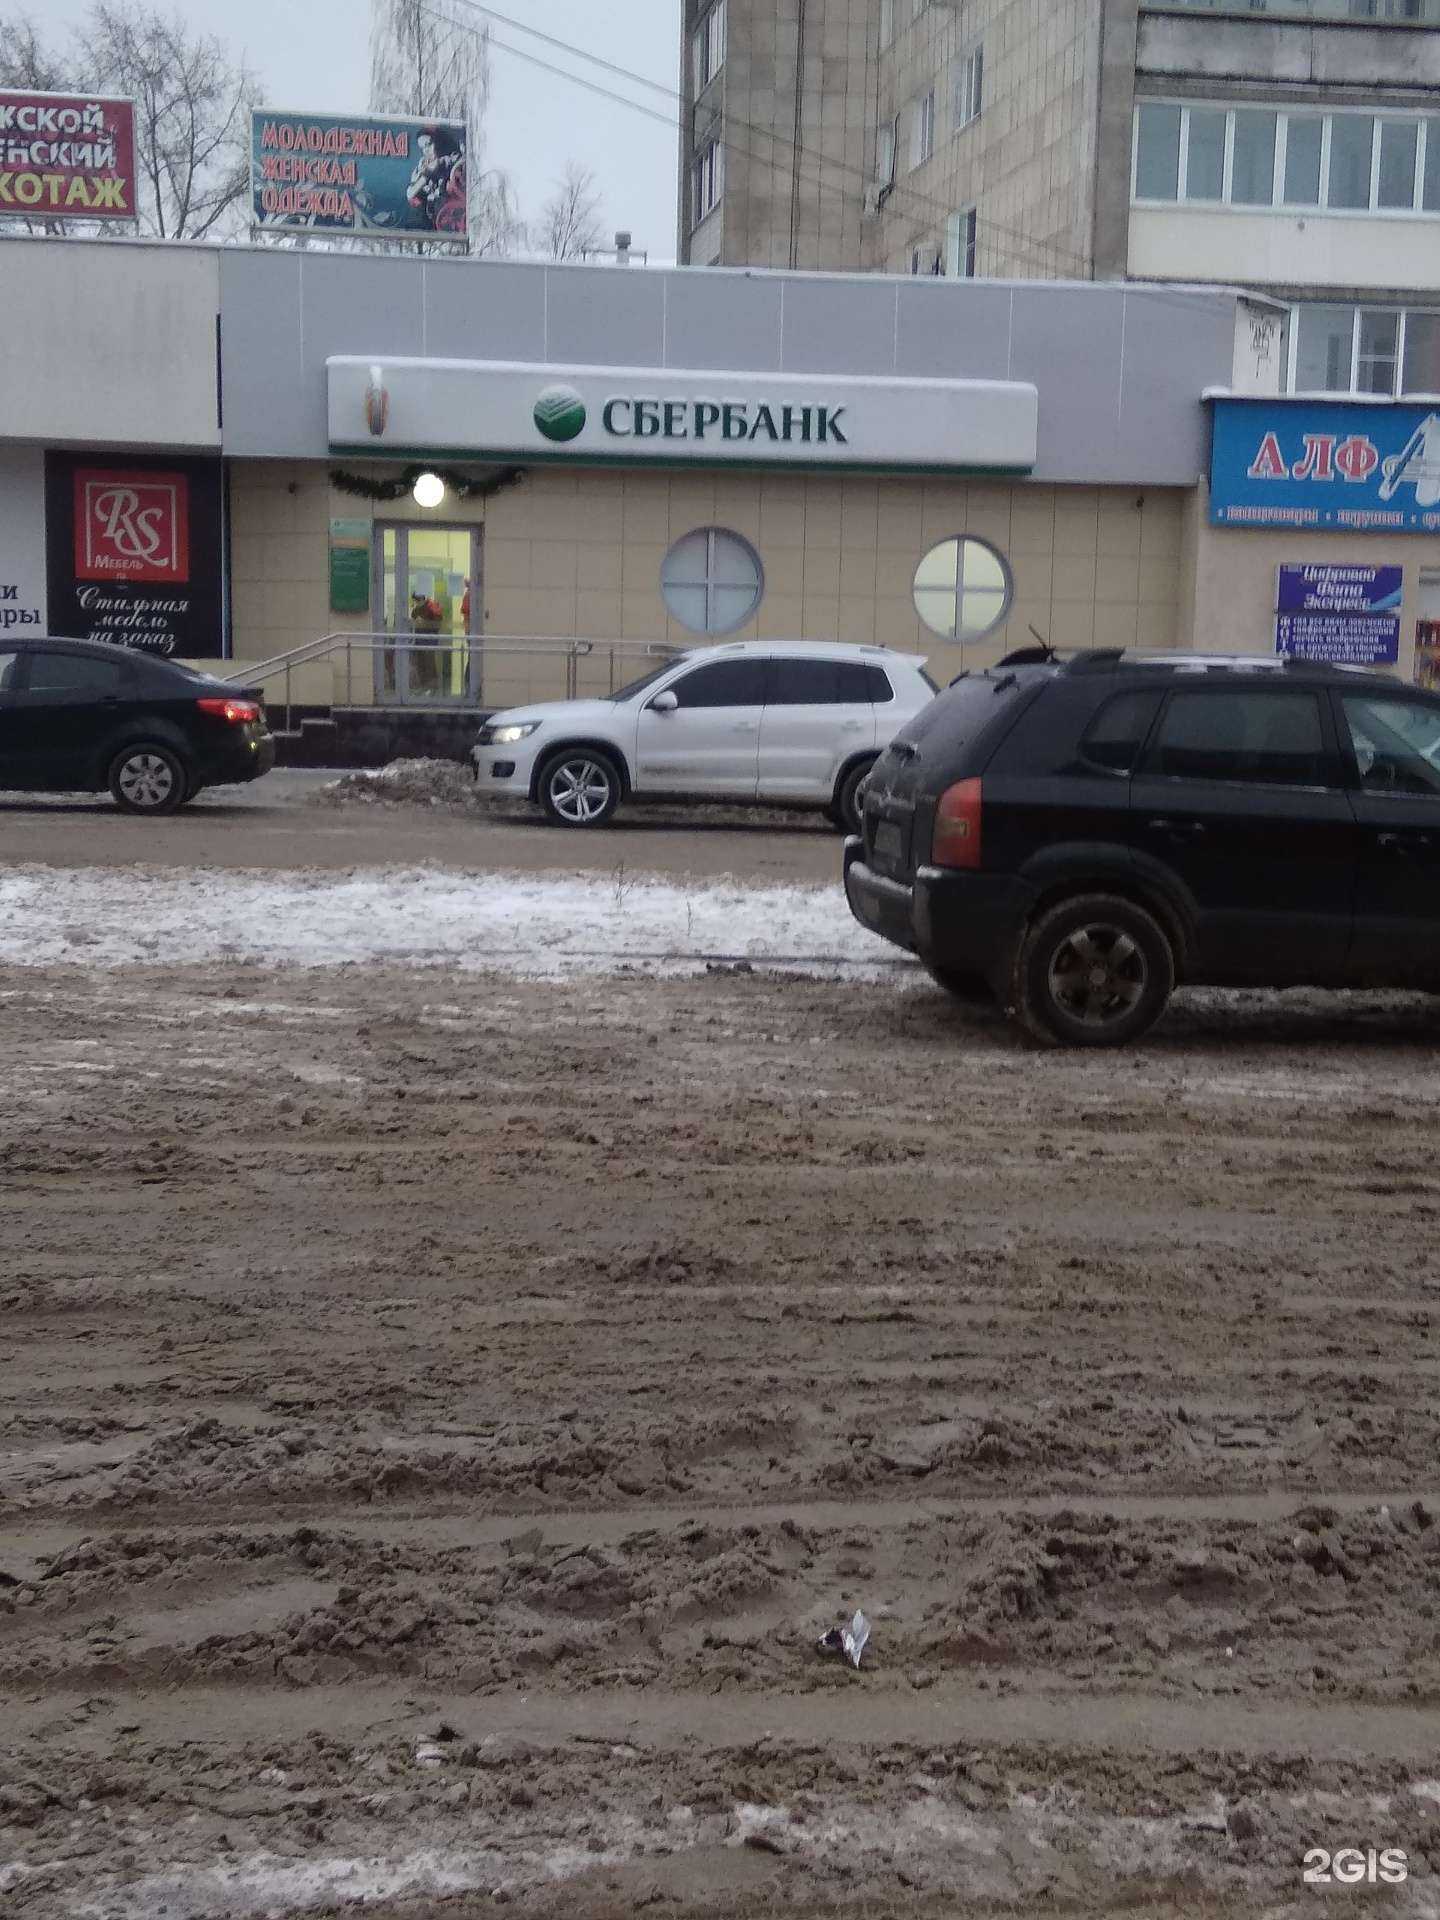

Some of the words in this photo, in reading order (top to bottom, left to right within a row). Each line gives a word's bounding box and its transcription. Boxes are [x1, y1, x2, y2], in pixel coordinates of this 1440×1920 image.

[0, 138, 117, 169] НСКИЙ
[261, 121, 409, 157] МОЛОДЕЖНАЯ
[261, 155, 358, 185] ЖЕНСКАЯ
[261, 187, 355, 217] ОДЕЖДА
[602, 398, 849, 443] СБЕРБАНК
[0, 608, 41, 629] ры
